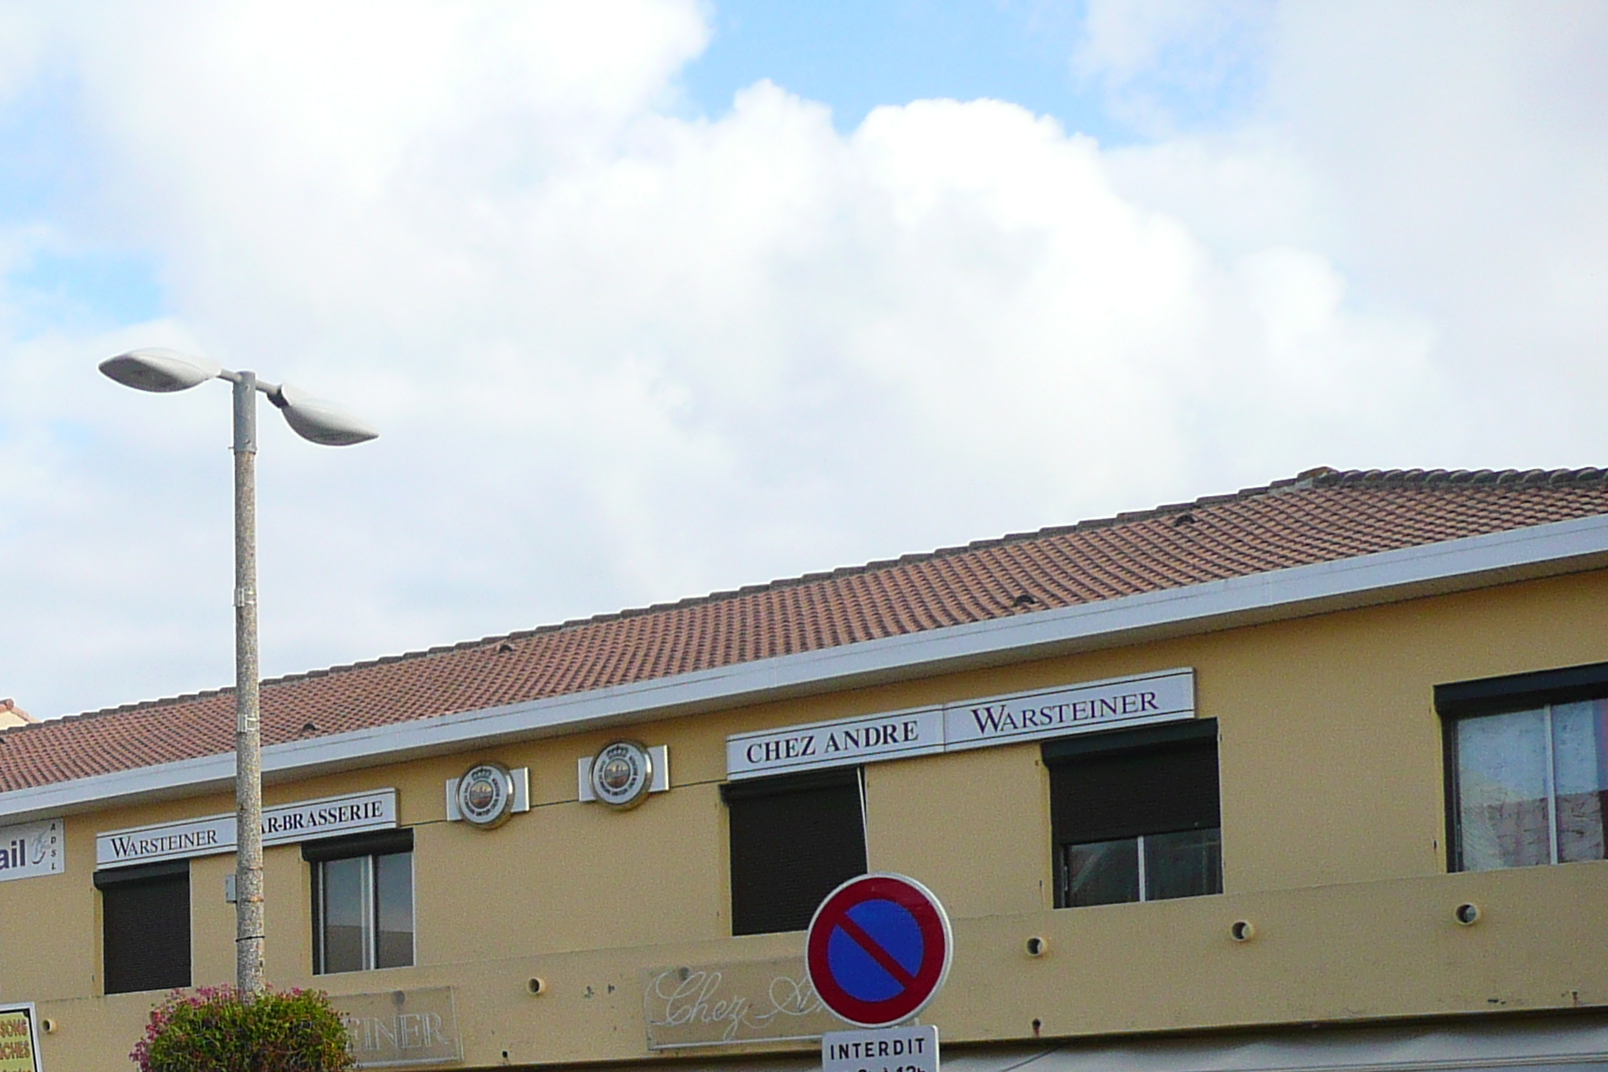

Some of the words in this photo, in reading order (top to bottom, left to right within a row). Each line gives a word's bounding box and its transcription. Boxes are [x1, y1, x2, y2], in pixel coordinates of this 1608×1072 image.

[745, 733, 817, 766] CHEZ
[824, 720, 919, 754] ANDRE
[970, 690, 1160, 735] WARSTEINER
[111, 828, 219, 859] WARSTEINER
[262, 800, 384, 836] R-BRASSERIE
[830, 1037, 926, 1060] INTERDIT
